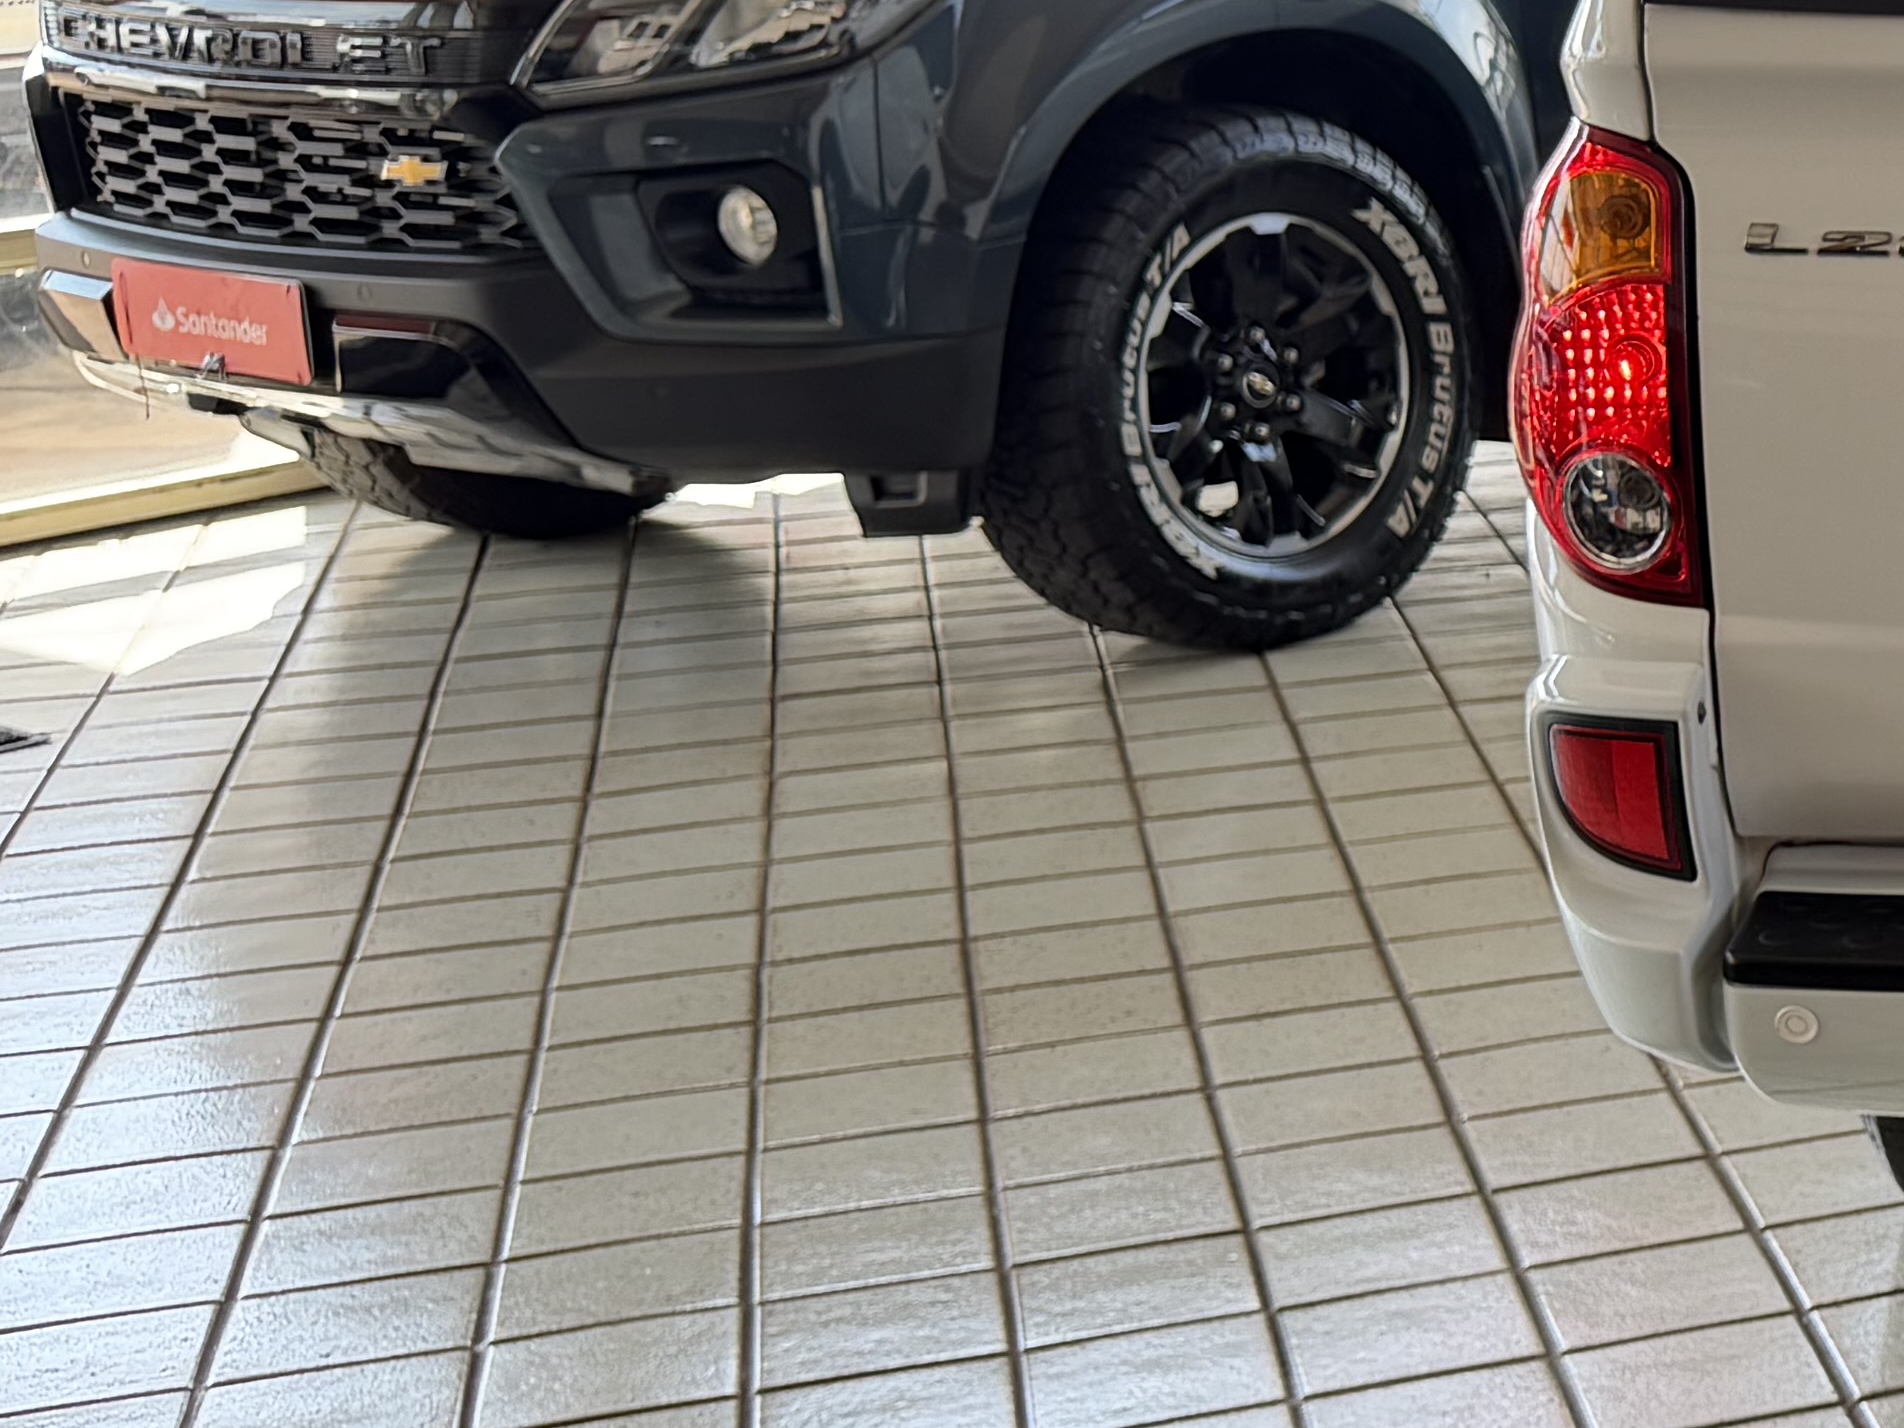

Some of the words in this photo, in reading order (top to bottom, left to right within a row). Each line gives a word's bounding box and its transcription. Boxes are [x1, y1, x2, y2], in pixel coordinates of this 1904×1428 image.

[61, 9, 442, 75] CHEVROLET
[175, 305, 268, 347] Santander
[1420, 321, 1457, 475] Brutus
[1386, 475, 1436, 539] T/A
